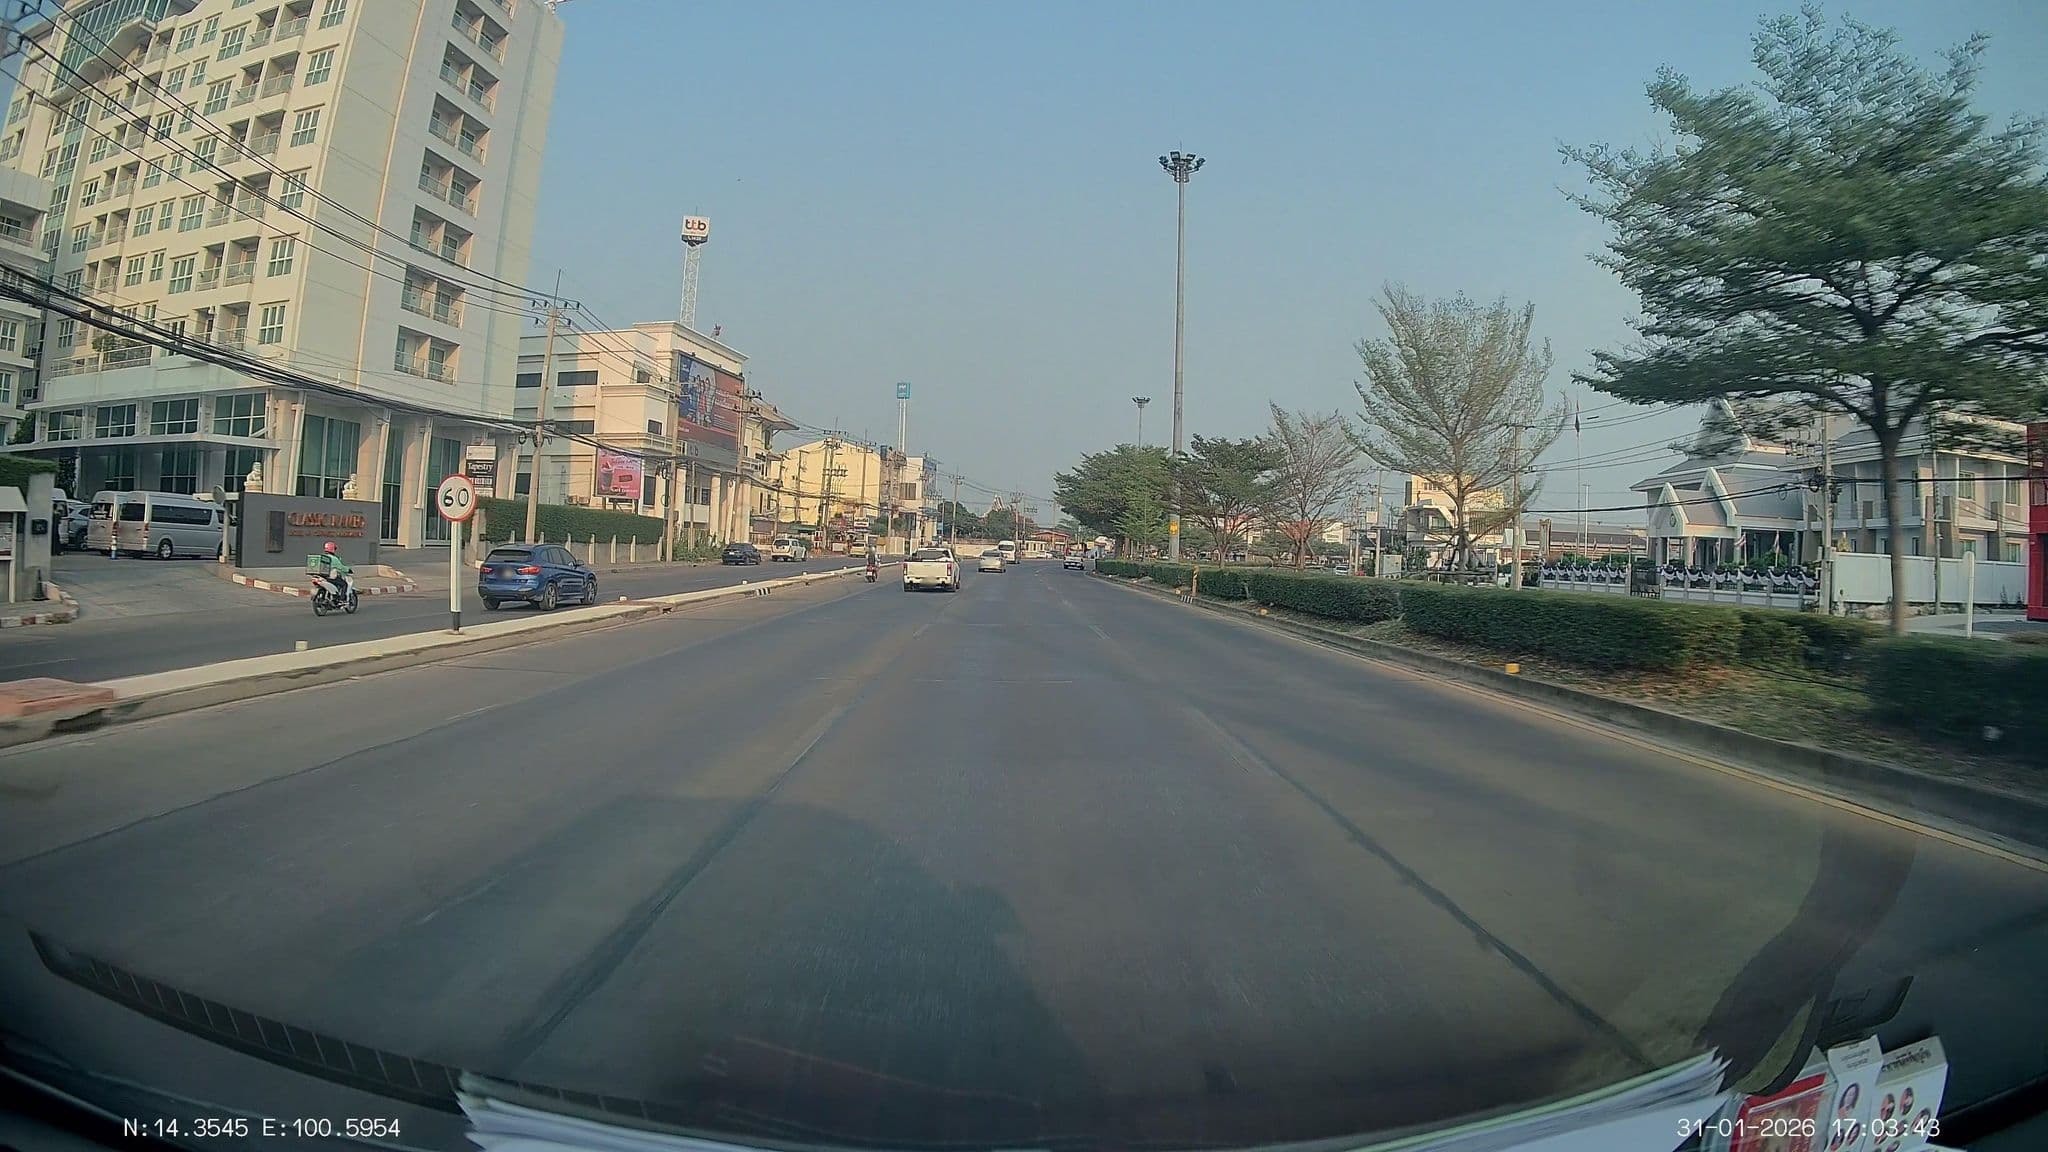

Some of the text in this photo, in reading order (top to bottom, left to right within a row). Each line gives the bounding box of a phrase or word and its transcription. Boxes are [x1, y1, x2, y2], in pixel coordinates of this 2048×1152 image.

[685, 219, 707, 231] ttb
[467, 462, 493, 472] Tapestry
[443, 487, 469, 507] 60
